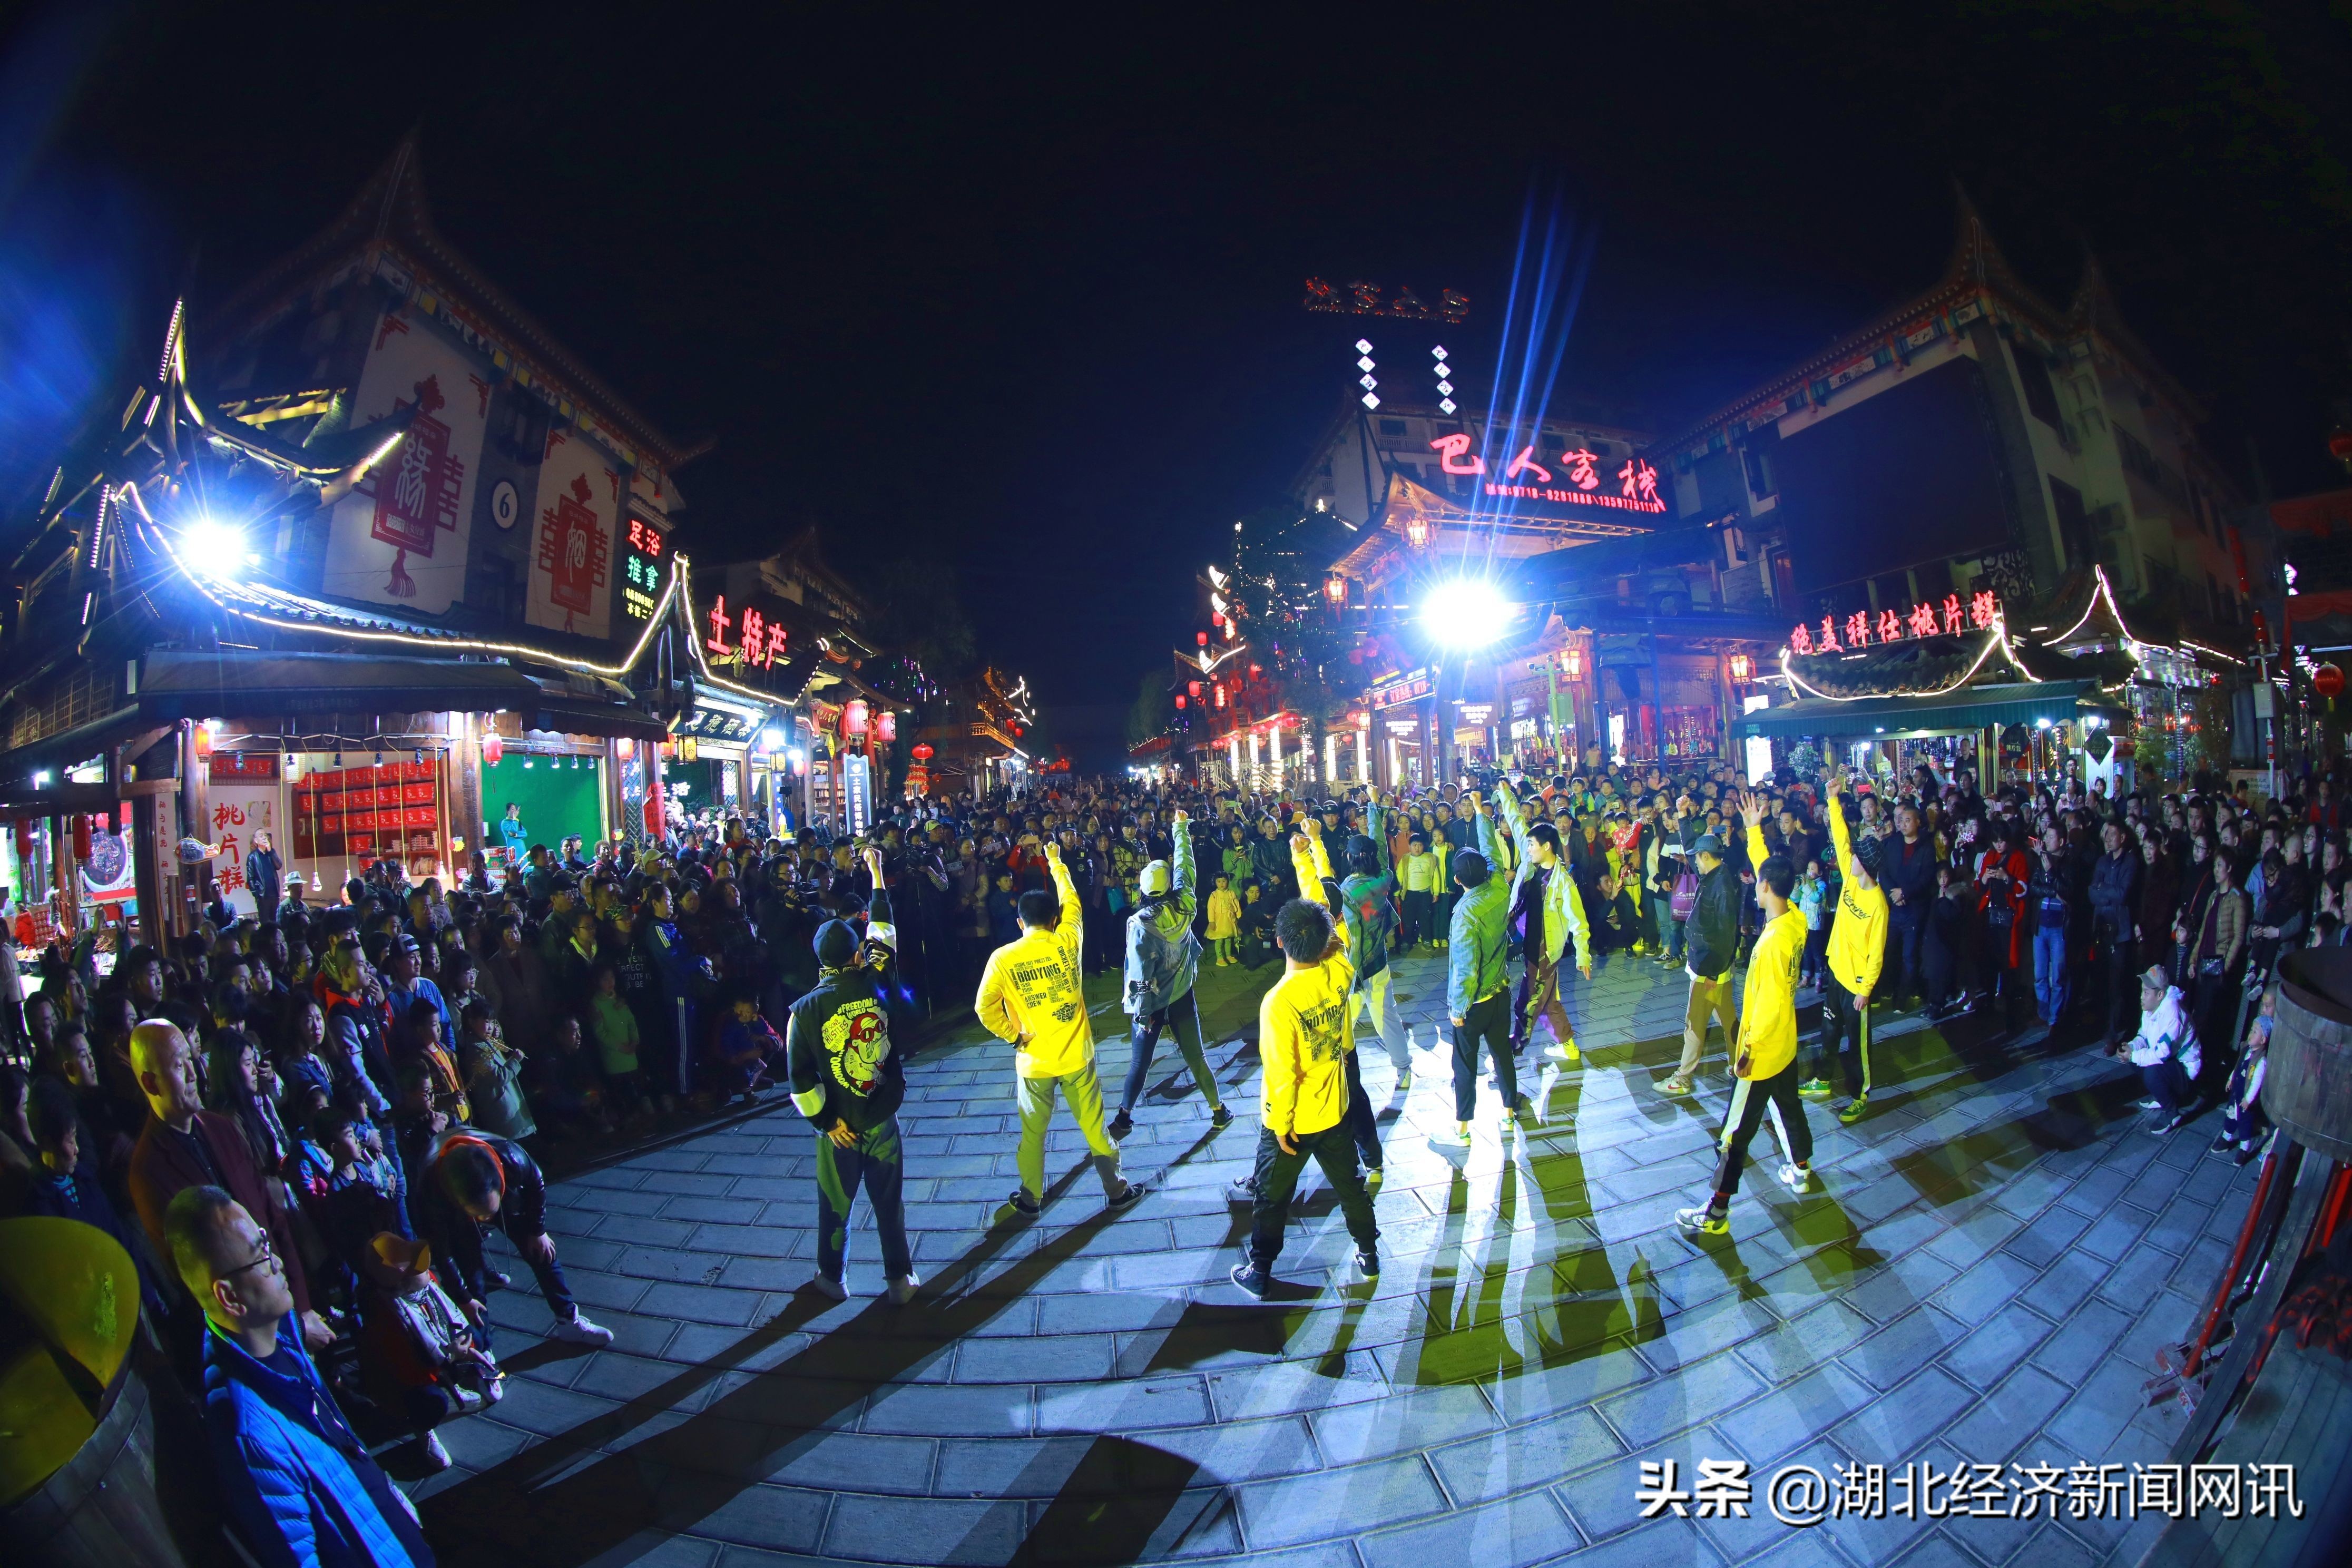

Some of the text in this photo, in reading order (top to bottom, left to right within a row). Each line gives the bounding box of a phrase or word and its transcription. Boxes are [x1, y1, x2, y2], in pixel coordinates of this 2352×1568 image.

[1430, 434, 1667, 512] 巴人客栈
[499, 493, 510, 518] 6
[629, 520, 661, 556] 足浴
[628, 555, 659, 592] 推拿
[708, 595, 787, 670] 土特产
[852, 777, 864, 837] 土家民俗博物馆
[212, 802, 245, 895] 桃片糕
[846, 1007, 866, 1020] WORLD
[1024, 992, 1047, 1003] ANSWER
[1026, 1000, 1042, 1009] CREW
[825, 1020, 849, 1045] HUSTLES
